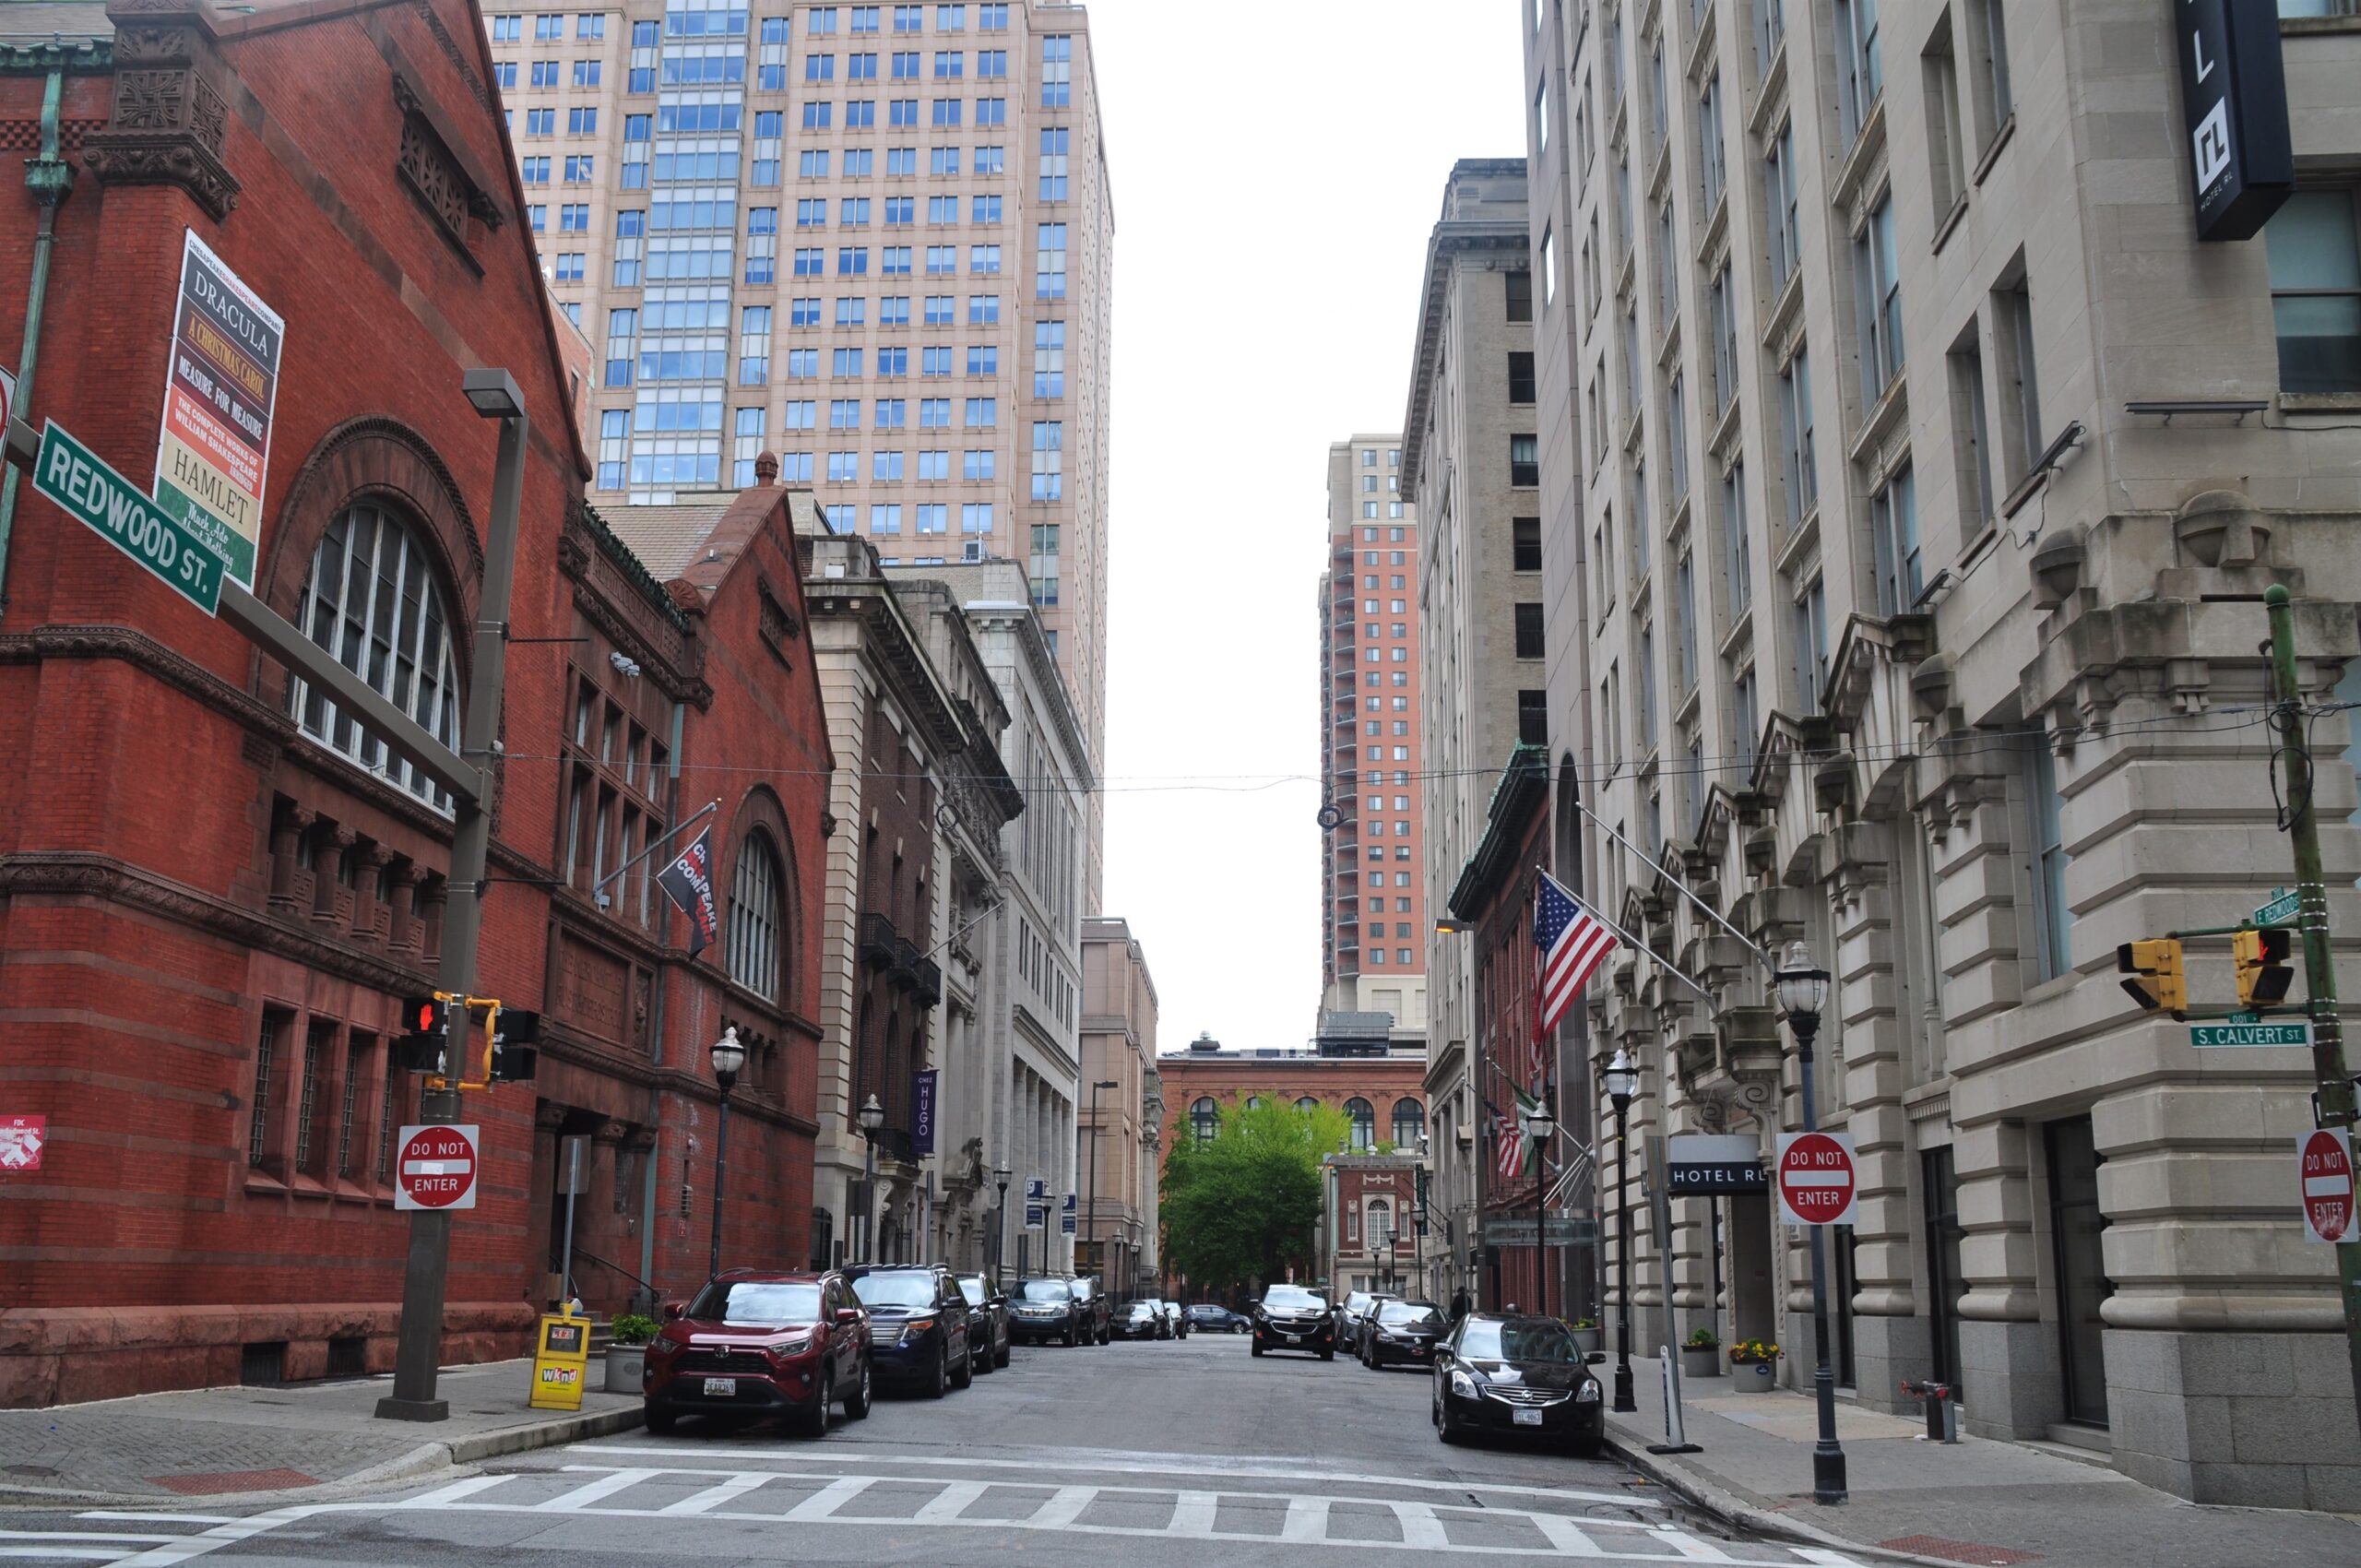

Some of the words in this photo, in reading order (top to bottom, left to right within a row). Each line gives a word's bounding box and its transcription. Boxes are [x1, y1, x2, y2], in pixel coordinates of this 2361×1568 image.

[2200, 186, 2224, 212] HOTEL
[2224, 171, 2234, 187] RL
[195, 270, 269, 358] DRACULA
[188, 316, 196, 339] A
[196, 323, 241, 377] CHRISTMAS
[240, 362, 266, 399] CAROL
[178, 355, 214, 400] MEASURE
[215, 386, 231, 414] FOR
[231, 399, 264, 442] MEASURE
[174, 408, 208, 443] WILLIAM
[208, 435, 258, 483] SHAKESPEARE
[178, 396, 192, 414] THE
[191, 409, 226, 443] COMPLETE
[226, 434, 249, 461] WORKS
[249, 455, 259, 468] OF
[173, 447, 249, 525] HAMLET
[47, 442, 177, 568] REDWOOD
[180, 548, 208, 594] ST.
[187, 501, 209, 532] Much
[209, 522, 230, 545] Ado
[2198, 1028, 2212, 1045] S.
[2216, 1027, 2284, 1044] CALVERT
[2287, 1029, 2302, 1040] ST.
[919, 1086, 929, 1136] HUGO
[411, 1143, 430, 1156] DO
[438, 1142, 465, 1155] NOT
[1790, 1151, 1809, 1166] DO
[1816, 1151, 1842, 1165] NOT
[2307, 1154, 2319, 1170] DO
[2323, 1151, 2343, 1170] NOT
[414, 1178, 458, 1192] ENTER
[1674, 1170, 1735, 1182] HOTEL
[1745, 1169, 1766, 1182] RL
[1797, 1192, 1840, 1206] ENTER
[2314, 1202, 2343, 1218] ENTER
[543, 1368, 577, 1383] Wknd
